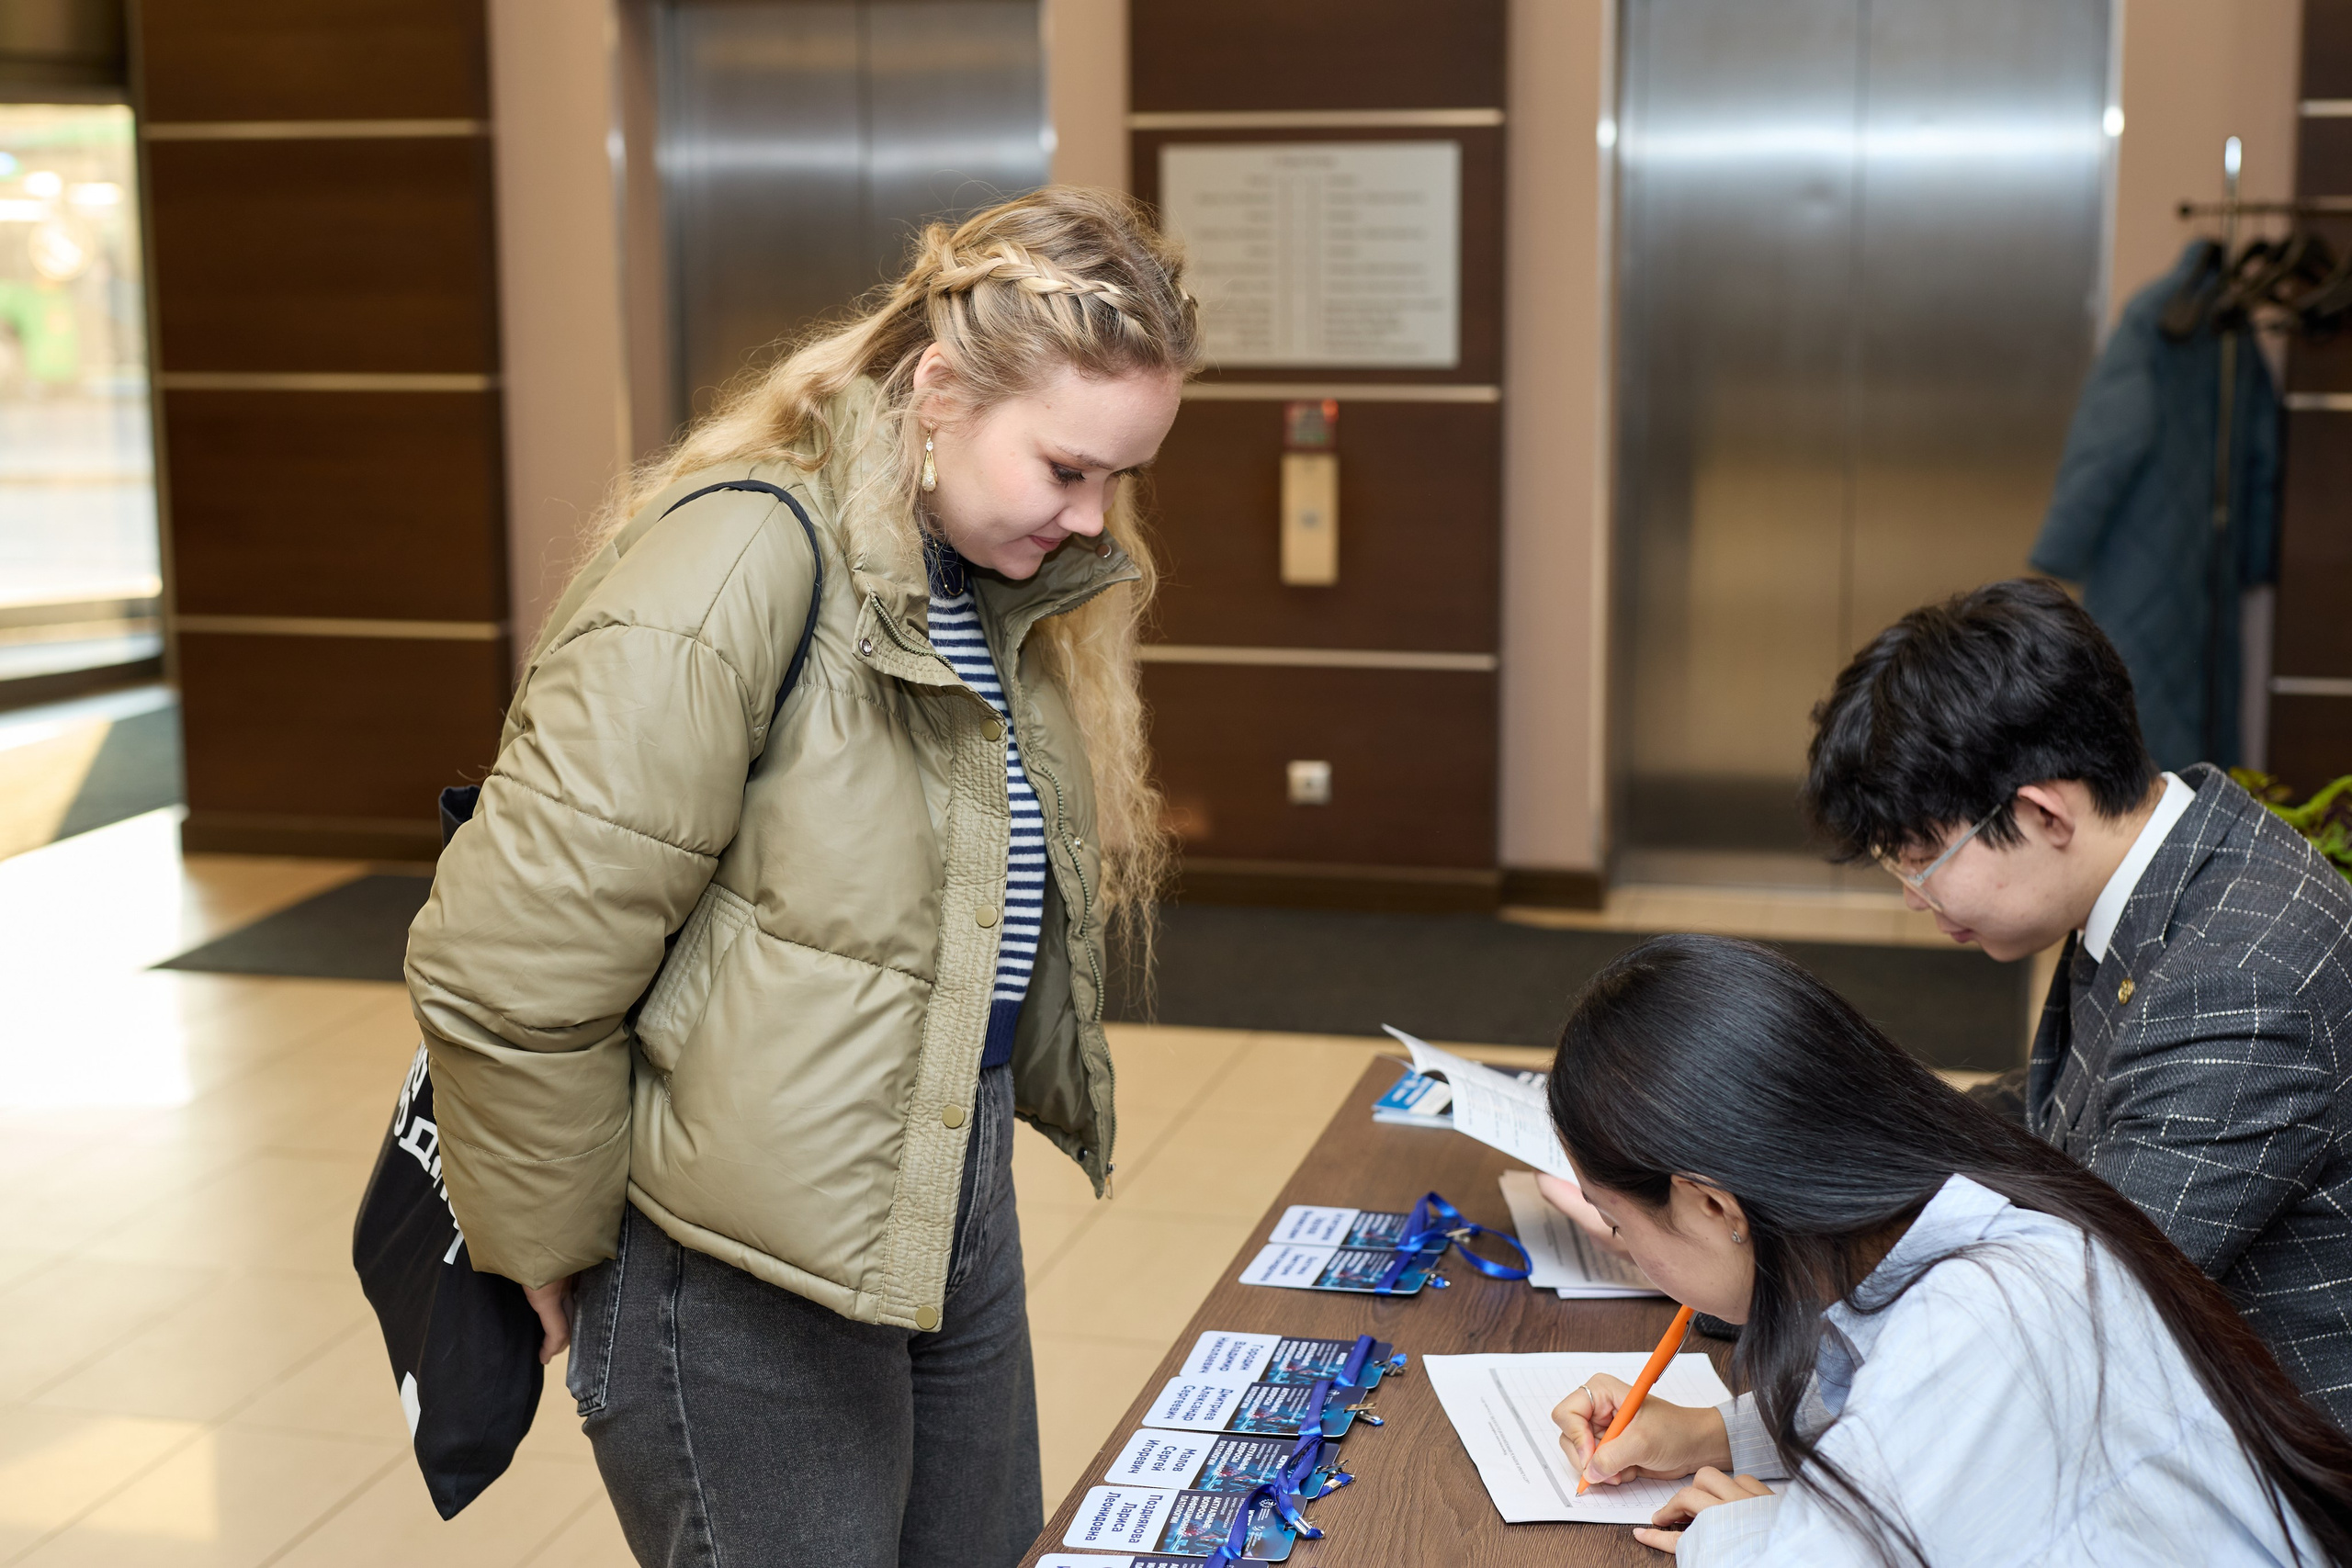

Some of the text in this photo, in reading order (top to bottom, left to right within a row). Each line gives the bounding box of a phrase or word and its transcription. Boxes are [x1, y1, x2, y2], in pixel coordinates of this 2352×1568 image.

[1200, 1337, 1230, 1373] Николаевич
[1219, 1341, 1247, 1371] Владимир
[1242, 1344, 1263, 1371] Городин
[1166, 1384, 1195, 1419] Сергеевич
[1182, 1385, 1215, 1421] Александр
[1204, 1388, 1234, 1420] Дмитриев
[1128, 1439, 1160, 1473] Игоревич
[1150, 1445, 1178, 1471] Сергей
[1172, 1449, 1196, 1472] Малов
[1207, 1439, 1227, 1465] ПАТОЛОГИИ
[1231, 1441, 1249, 1462] ВОПРОСЫ
[1238, 1442, 1259, 1471] АКТУАЛЬНЫЕ
[1085, 1492, 1122, 1540] Леонидовна
[1112, 1502, 1137, 1532] Лариса
[1128, 1495, 1162, 1543] Позднякова
[1170, 1495, 1189, 1523] ПАТОЛОГИИ
[1175, 1495, 1200, 1535] ИНФЕКЦИОННОЙ
[1193, 1495, 1211, 1519] ВОПРОСЫ
[1202, 1496, 1222, 1529] АКТУАЛЬНЫЕ
